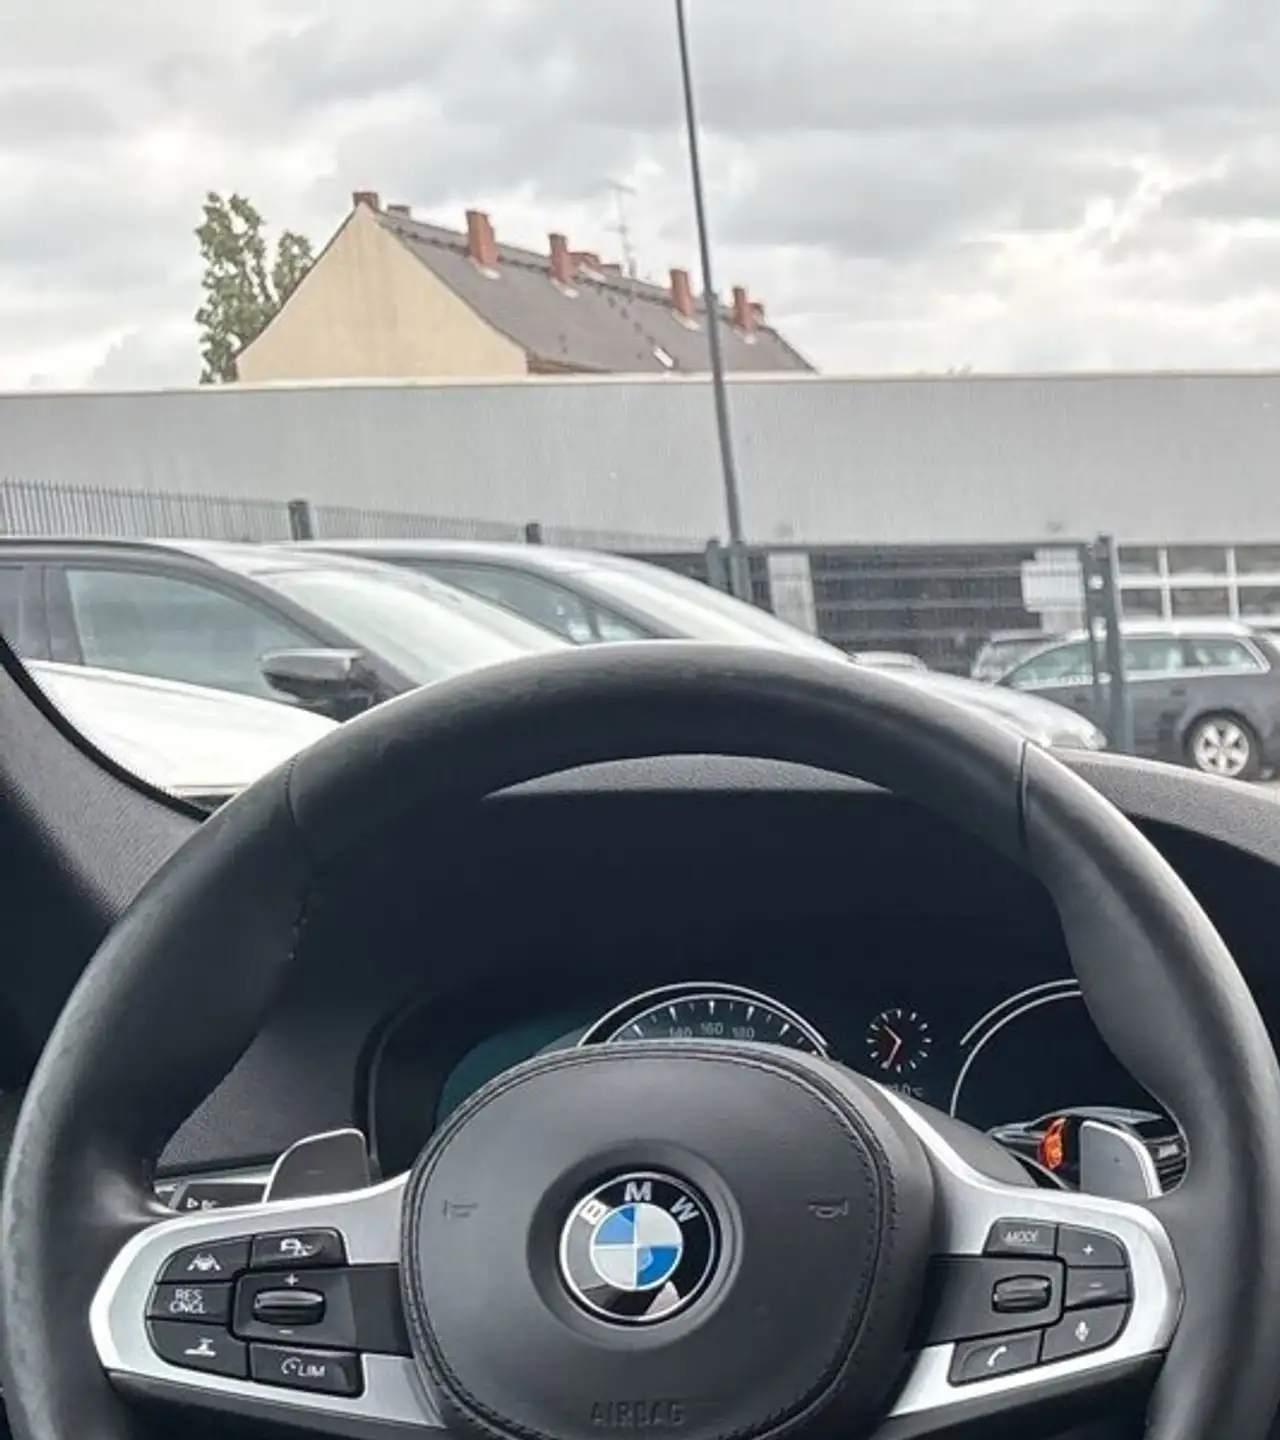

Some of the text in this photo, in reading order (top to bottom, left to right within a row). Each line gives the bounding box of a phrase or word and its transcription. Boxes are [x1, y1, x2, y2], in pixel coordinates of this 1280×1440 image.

[578, 1181, 699, 1226] BMW
[1004, 1230, 1038, 1243] MODE
[175, 1288, 203, 1300] RES
[170, 1300, 207, 1314] CNCL
[297, 1363, 326, 1378] LIM
[591, 1401, 685, 1428] AIRBAG
